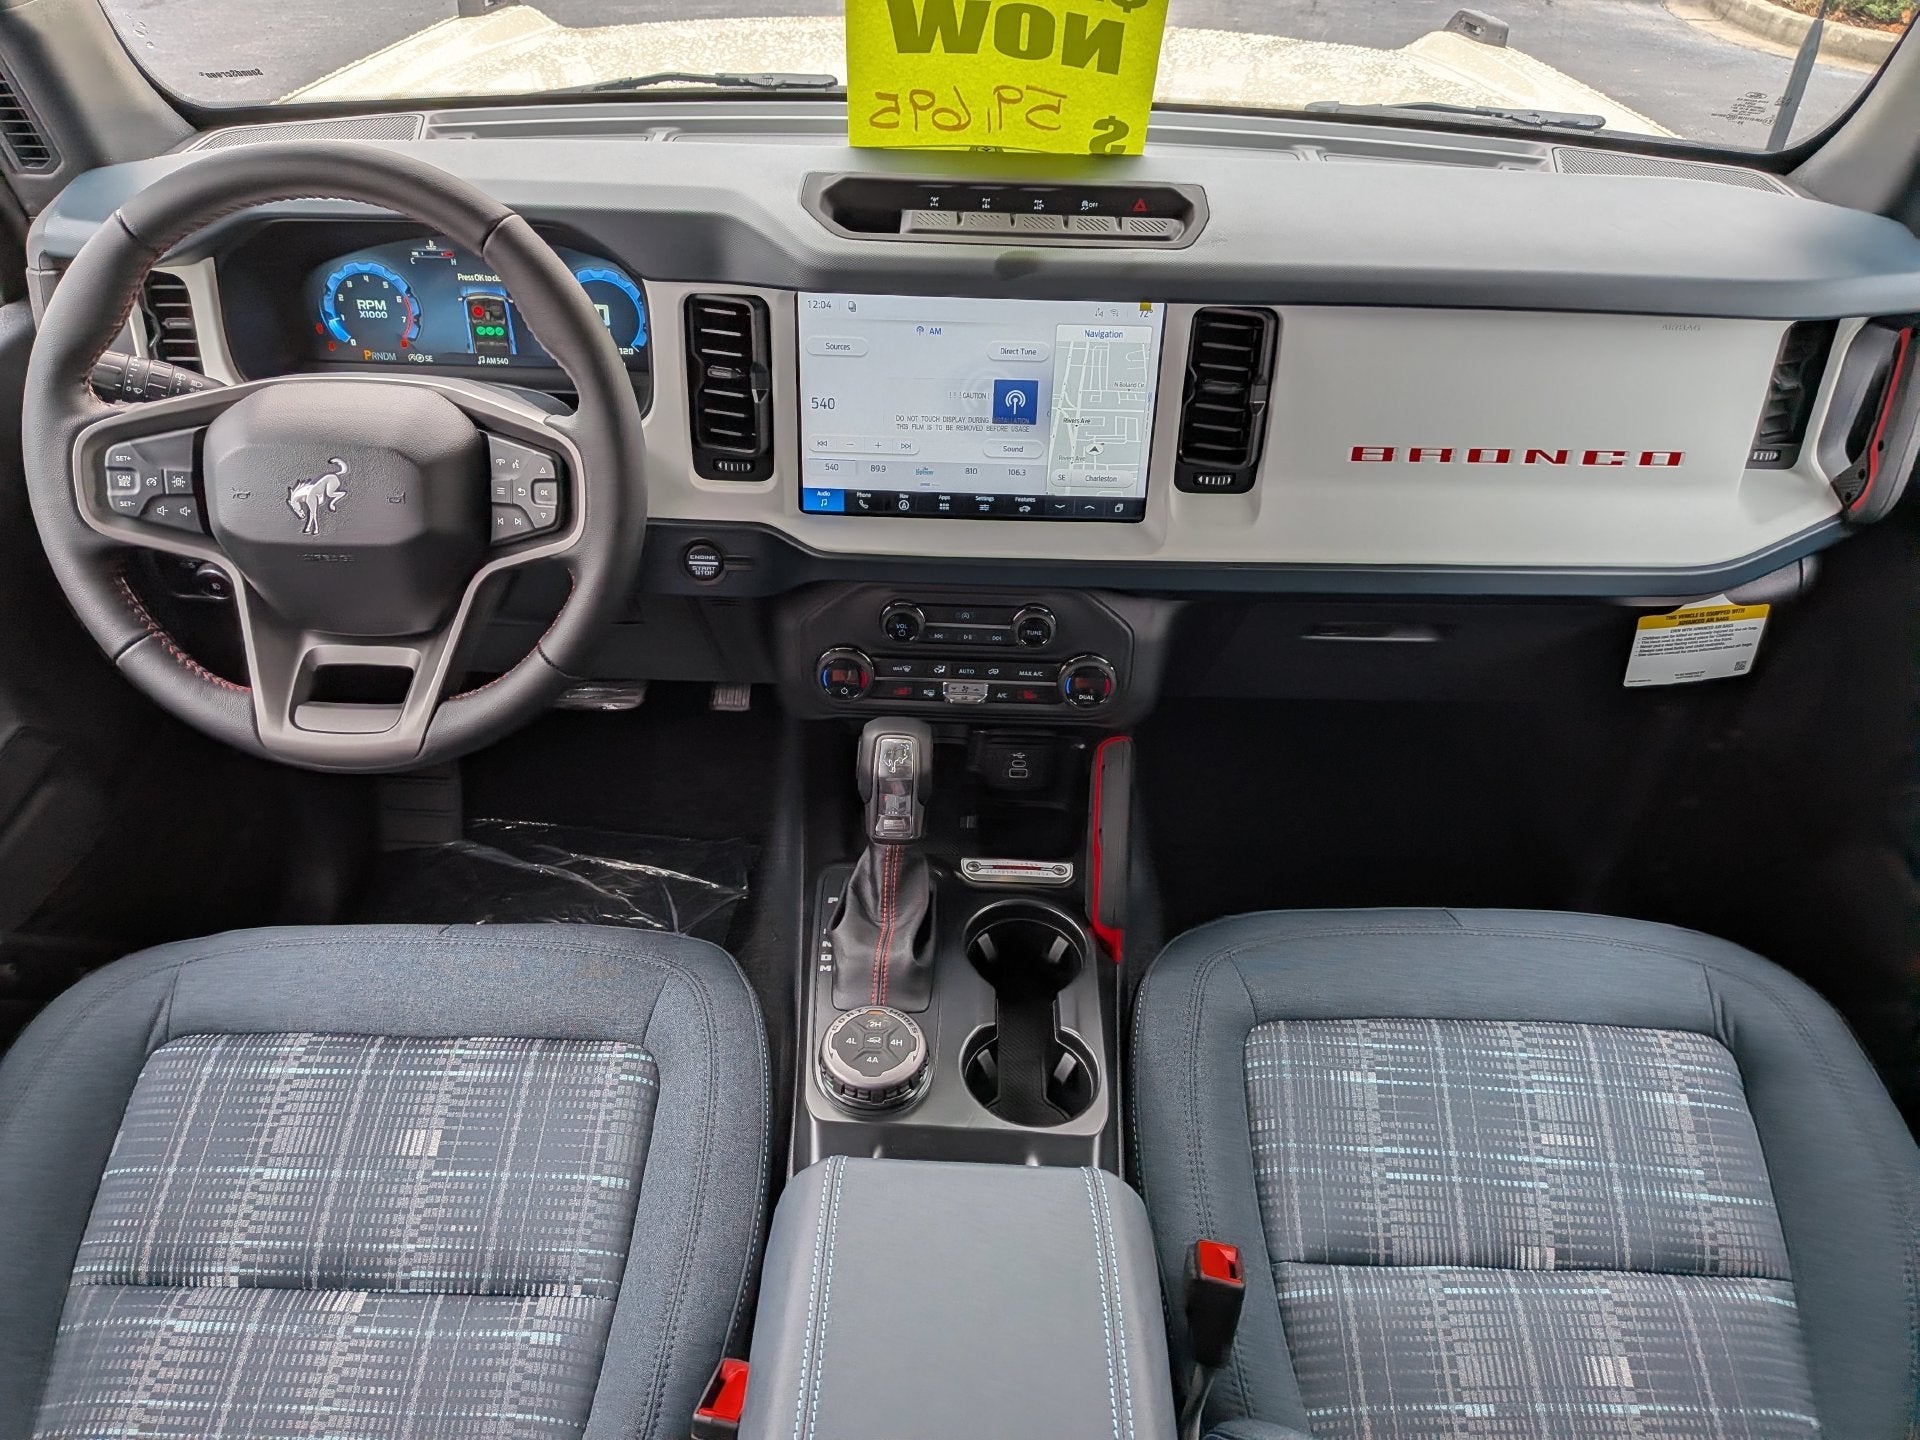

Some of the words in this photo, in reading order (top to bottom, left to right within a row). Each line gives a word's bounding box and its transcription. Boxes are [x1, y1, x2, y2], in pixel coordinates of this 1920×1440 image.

[457, 273, 474, 281] Press
[474, 273, 485, 281] OK
[485, 274, 492, 282] to
[356, 299, 387, 310] RPM
[807, 300, 832, 309] 12:04
[359, 310, 388, 319] X1000
[1085, 330, 1124, 340] Navigation
[825, 342, 851, 351] Sources
[1000, 347, 1019, 355] Direct
[486, 357, 496, 365] AM
[497, 357, 509, 365] 540
[811, 397, 835, 410] 540
[1003, 445, 1024, 453] Sound
[1349, 446, 1685, 466] BRONCO
